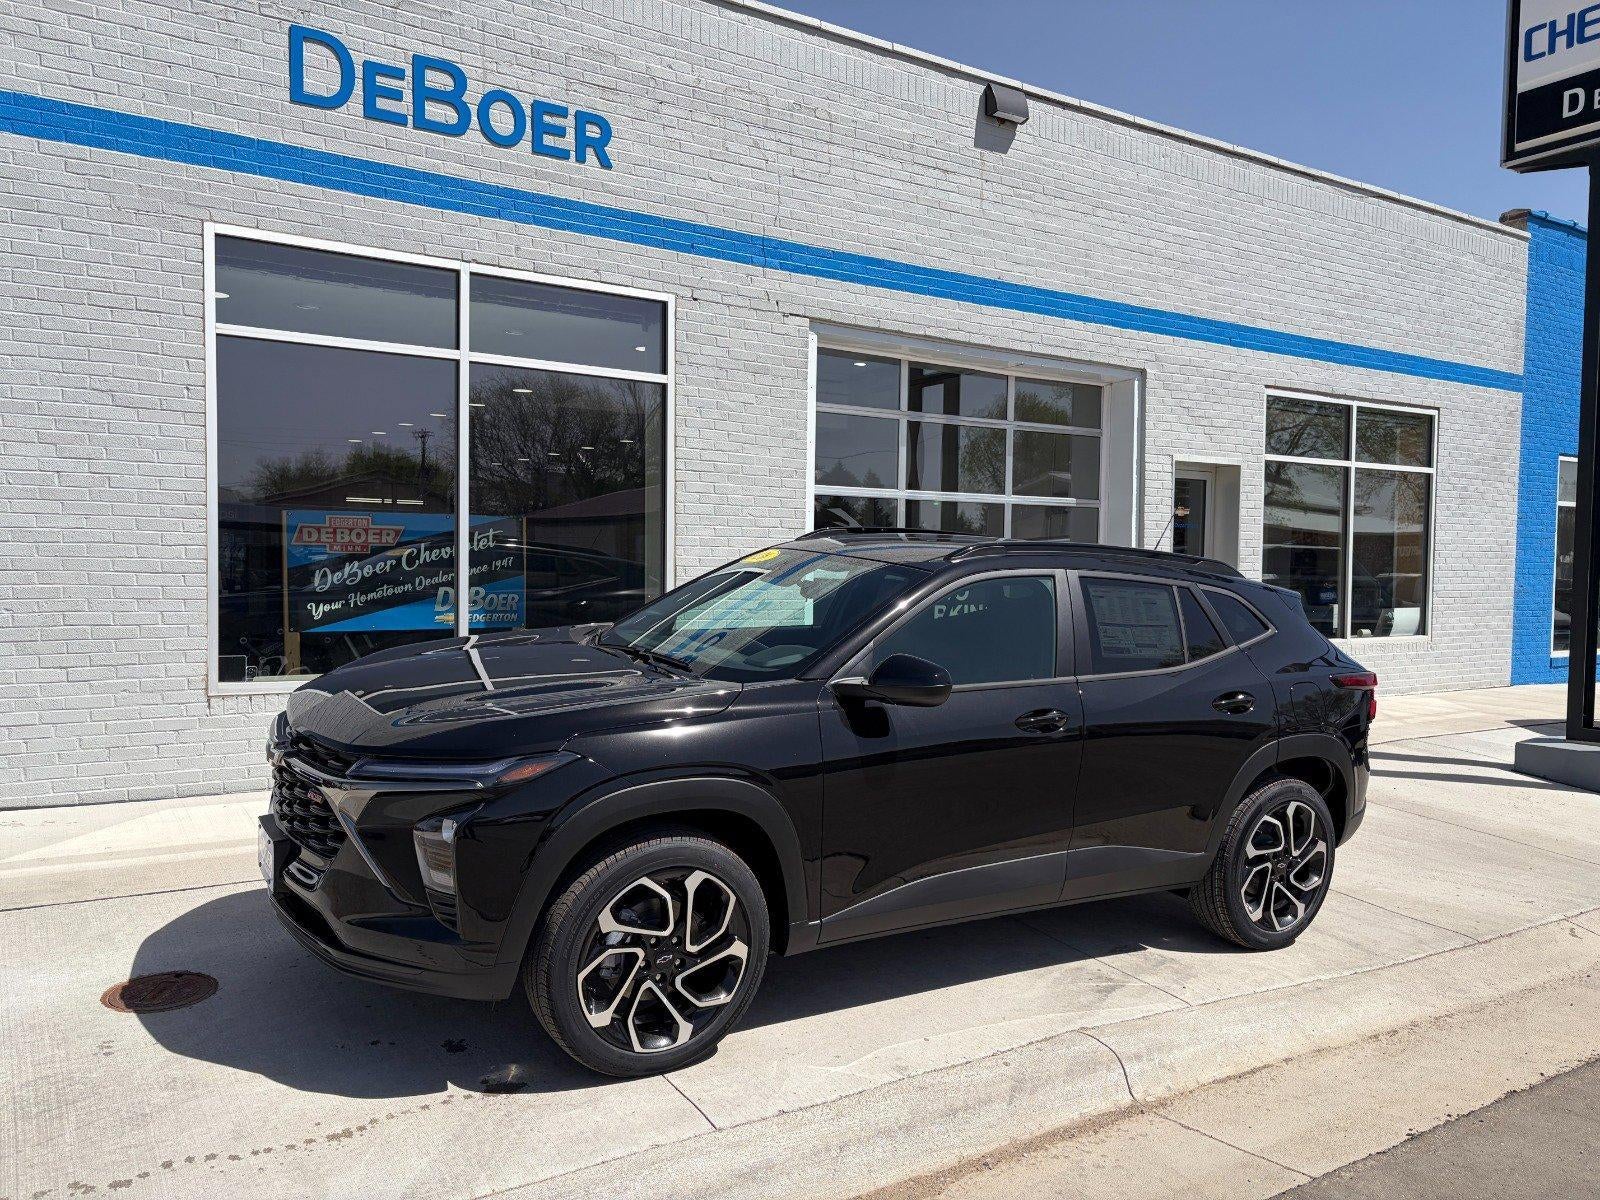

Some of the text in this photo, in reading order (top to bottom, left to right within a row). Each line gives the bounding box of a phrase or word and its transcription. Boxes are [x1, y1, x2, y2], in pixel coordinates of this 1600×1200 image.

[331, 517, 368, 527] EDGERTON
[302, 528, 396, 544] DEBOER
[314, 527, 504, 593] DeBoer Chevlet
[306, 599, 346, 620] Your
[348, 582, 414, 608] Hometown
[415, 571, 455, 591] Dealer
[491, 556, 514, 571] 1947
[434, 586, 520, 612] DBOER
[468, 612, 518, 623] EDGERTON
